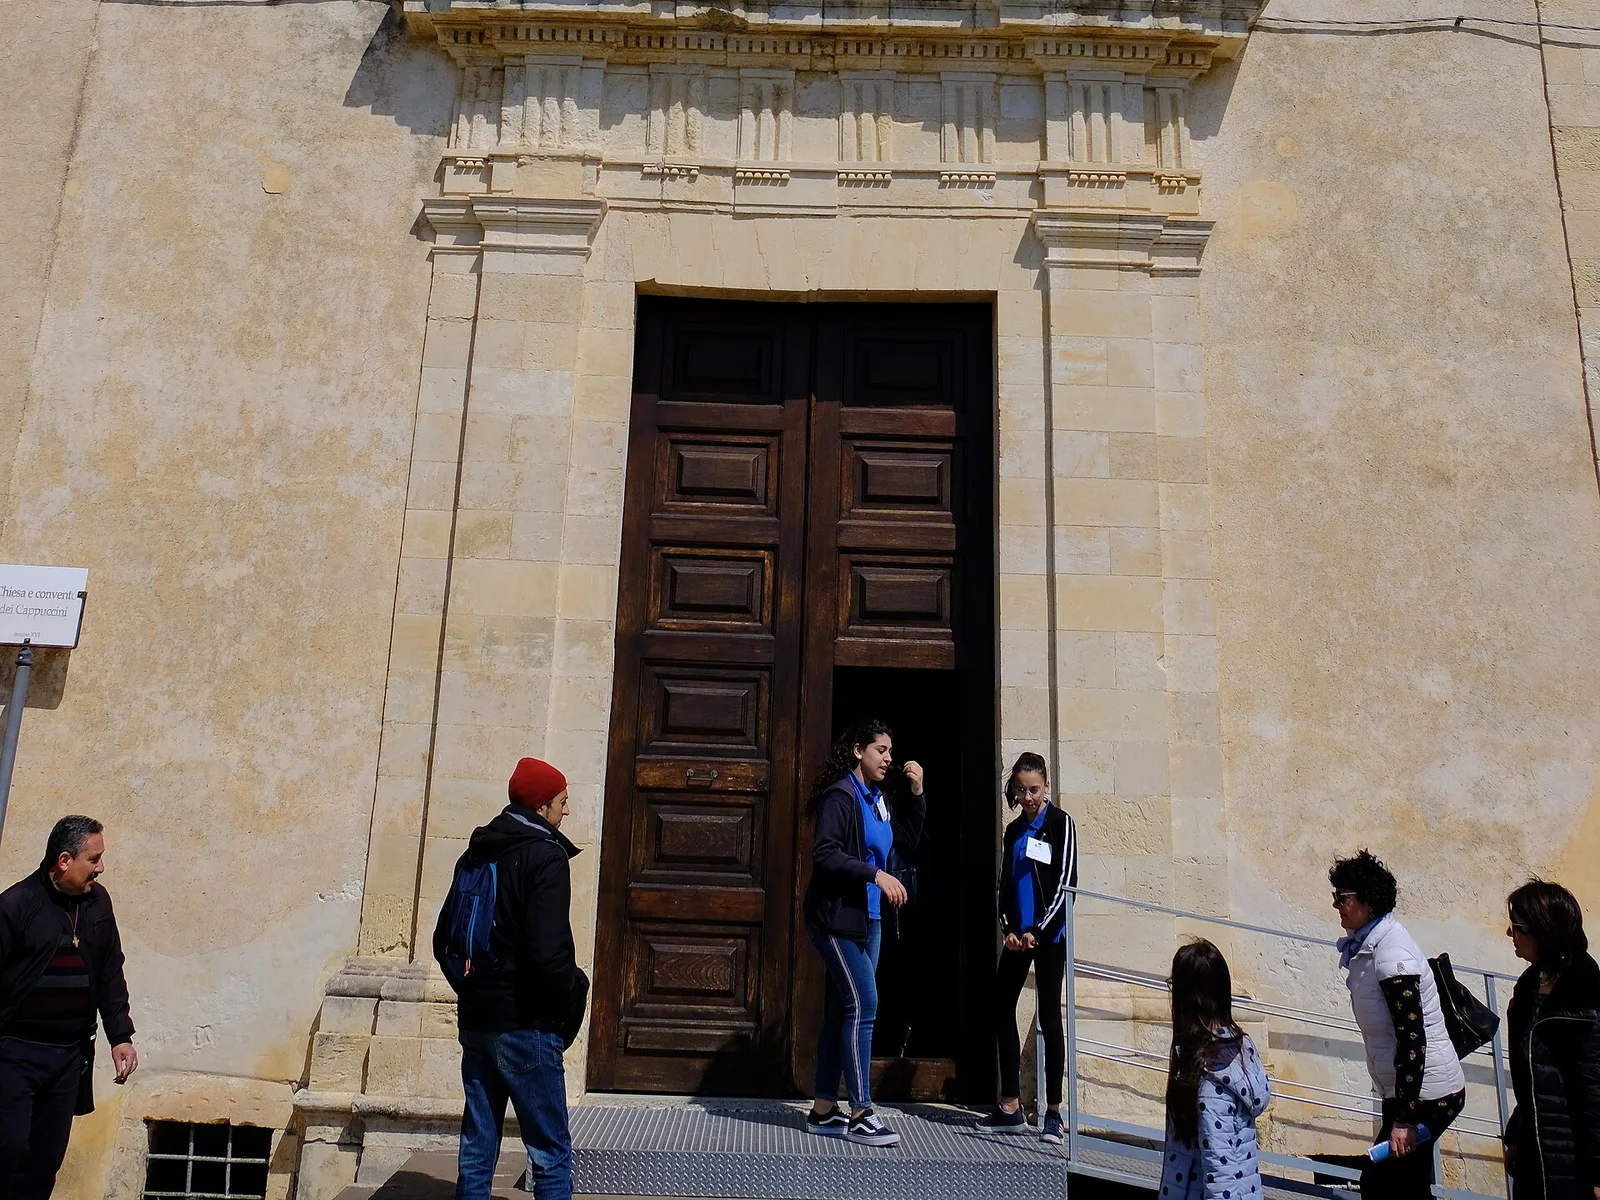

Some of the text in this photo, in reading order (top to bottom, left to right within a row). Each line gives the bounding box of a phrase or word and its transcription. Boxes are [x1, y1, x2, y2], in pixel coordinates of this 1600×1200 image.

[28, 590, 34, 598] e
[0, 603, 68, 619] dei Cappuccini
